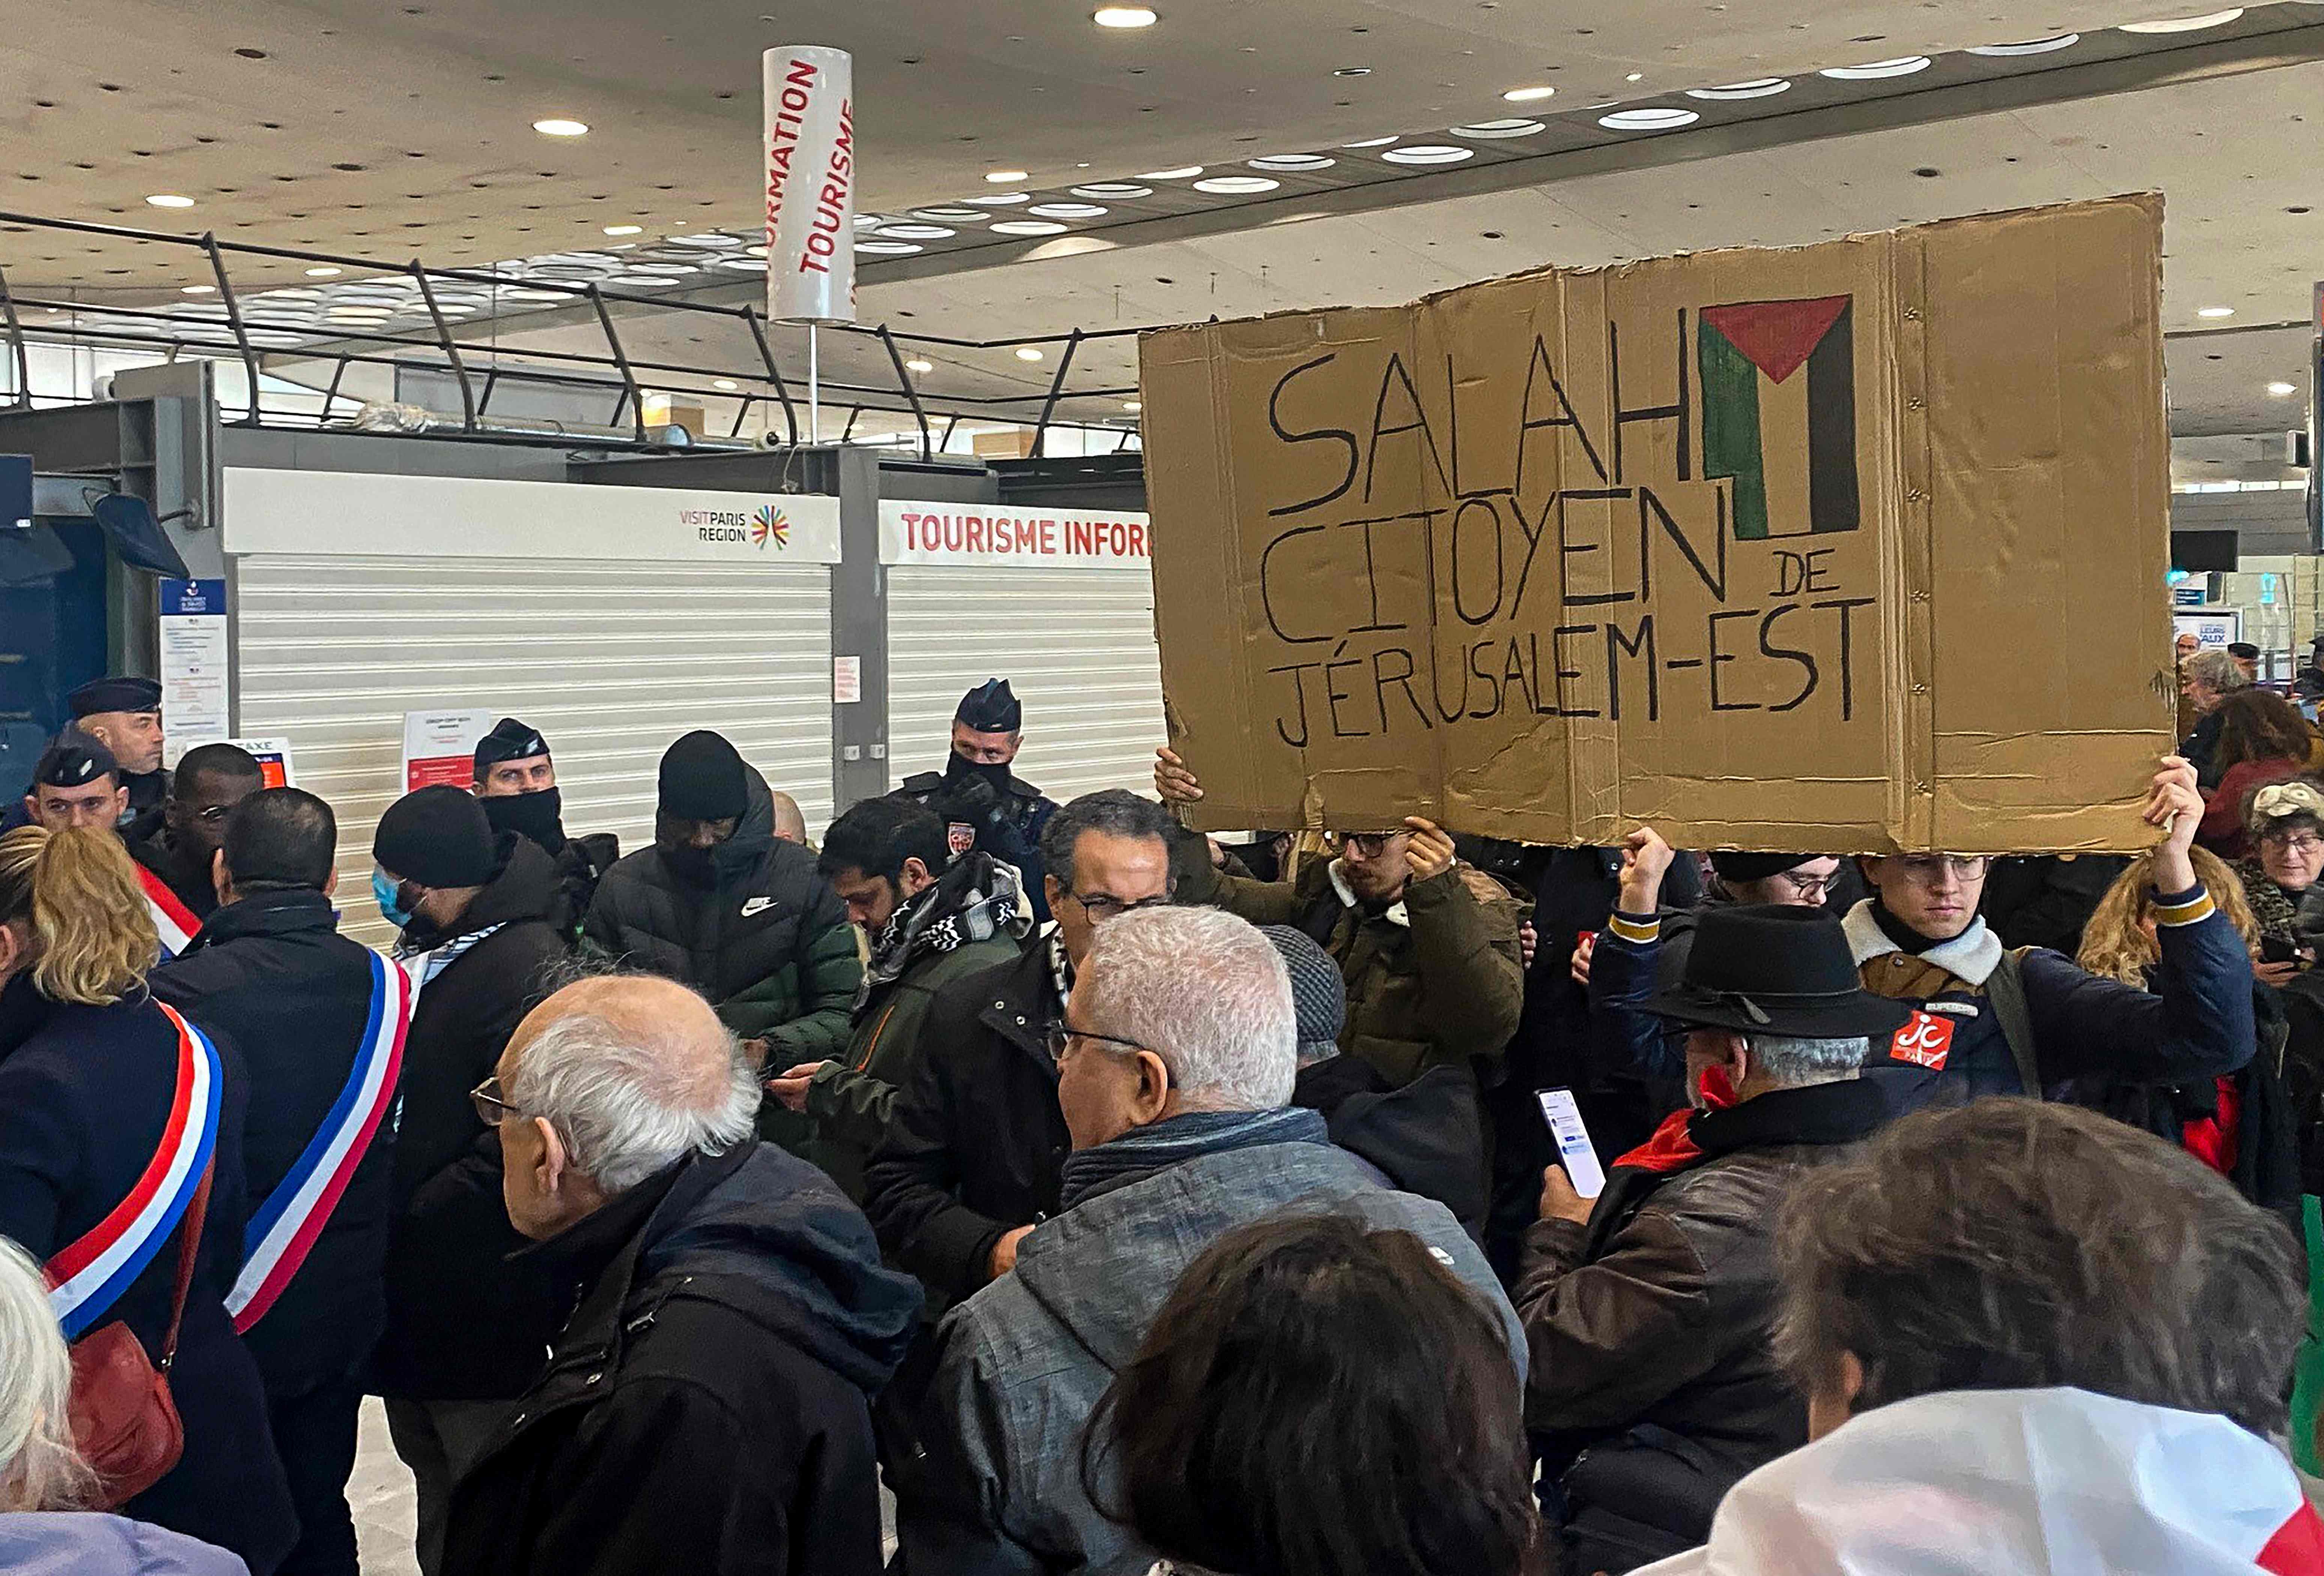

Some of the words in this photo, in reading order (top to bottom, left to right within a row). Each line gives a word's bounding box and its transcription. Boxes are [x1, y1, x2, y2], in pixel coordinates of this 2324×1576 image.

[799, 98, 853, 274] TOURISME
[1269, 307, 1691, 517] SALAH
[699, 528, 746, 541] REGION
[901, 513, 1056, 554] TOURISME
[1064, 521, 1153, 557] INFOR
[1261, 484, 1726, 643] CITOYEN
[1769, 548, 1841, 597] DE
[1265, 597, 1876, 748] JÉRUSALEM-EST
[2200, 634, 2225, 642] AUX
